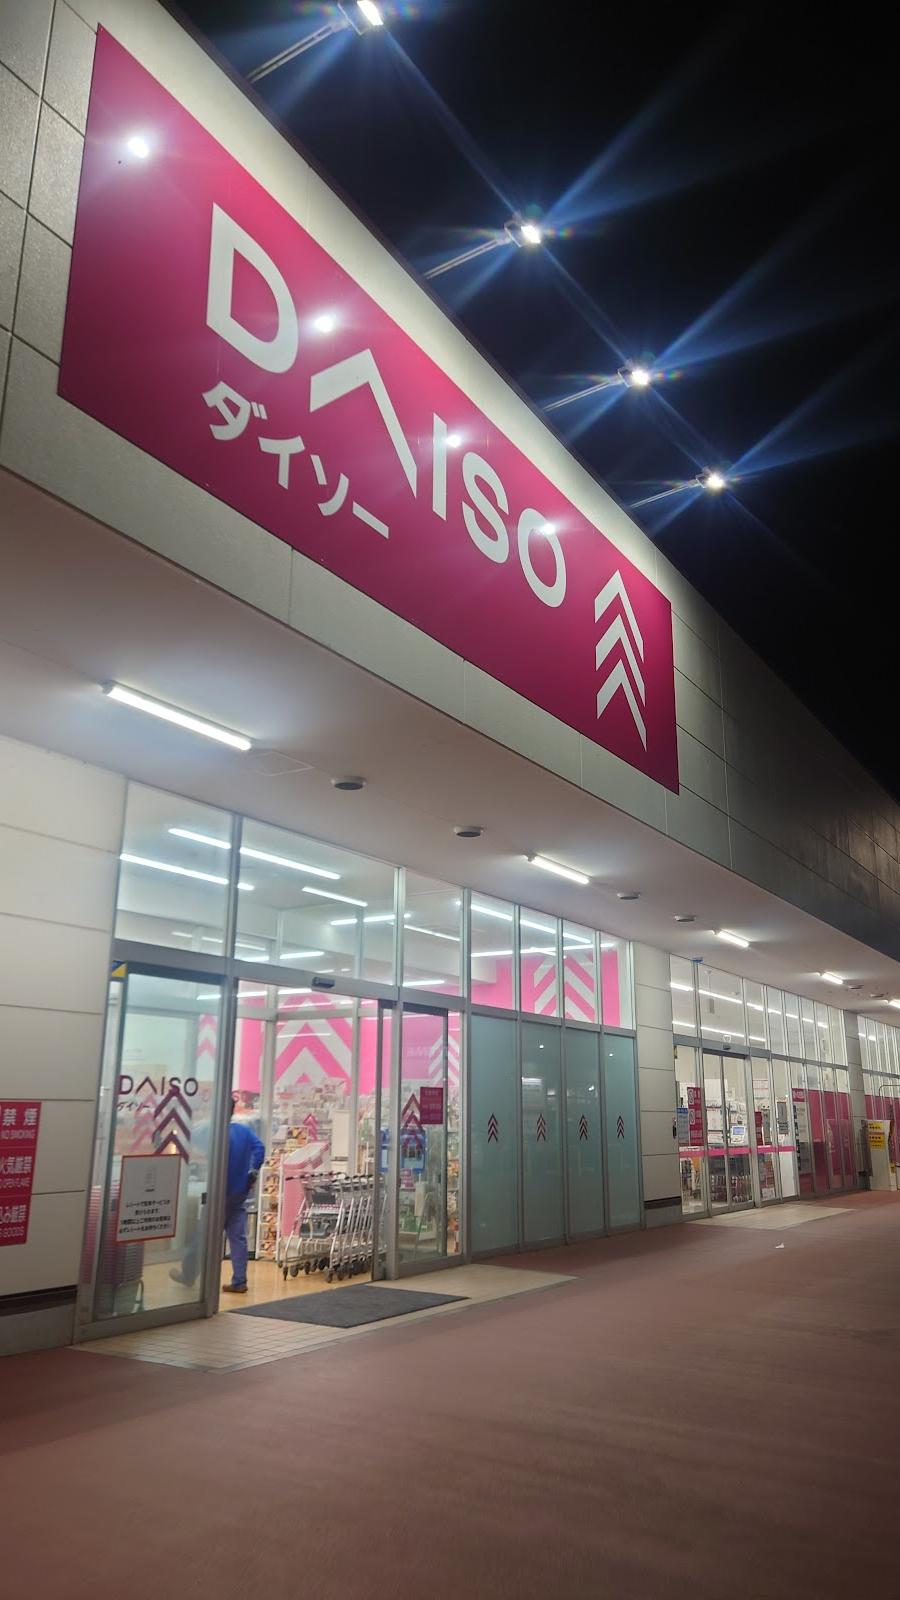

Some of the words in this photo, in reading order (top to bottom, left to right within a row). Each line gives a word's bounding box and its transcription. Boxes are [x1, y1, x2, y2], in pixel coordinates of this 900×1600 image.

[202, 381, 390, 540] ダイソー
[206, 202, 567, 608] DAISO
[118, 1075, 199, 1097] DAISO
